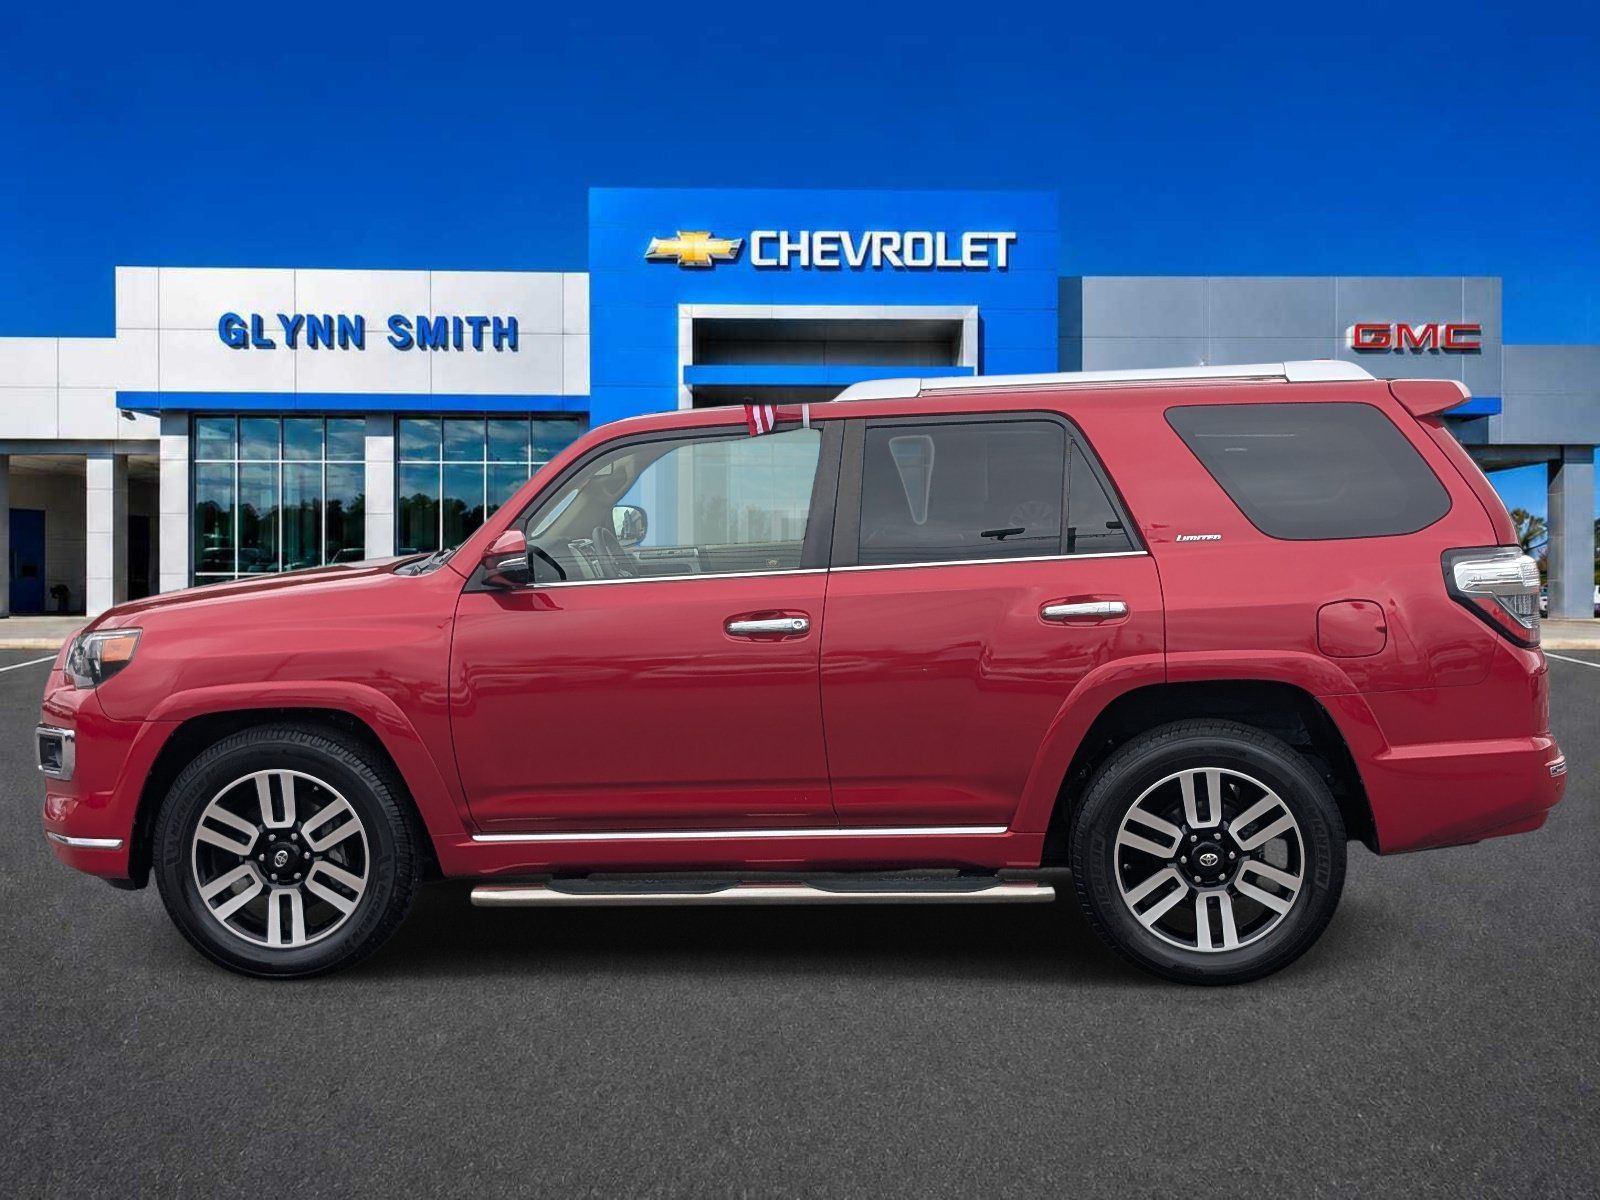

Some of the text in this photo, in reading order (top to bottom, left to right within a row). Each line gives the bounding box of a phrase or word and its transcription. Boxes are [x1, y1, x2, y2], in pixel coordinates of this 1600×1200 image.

[750, 230, 1017, 267] CHEVROLET
[218, 311, 519, 352] GLYNN SMITH
[1350, 323, 1482, 352] GMC
